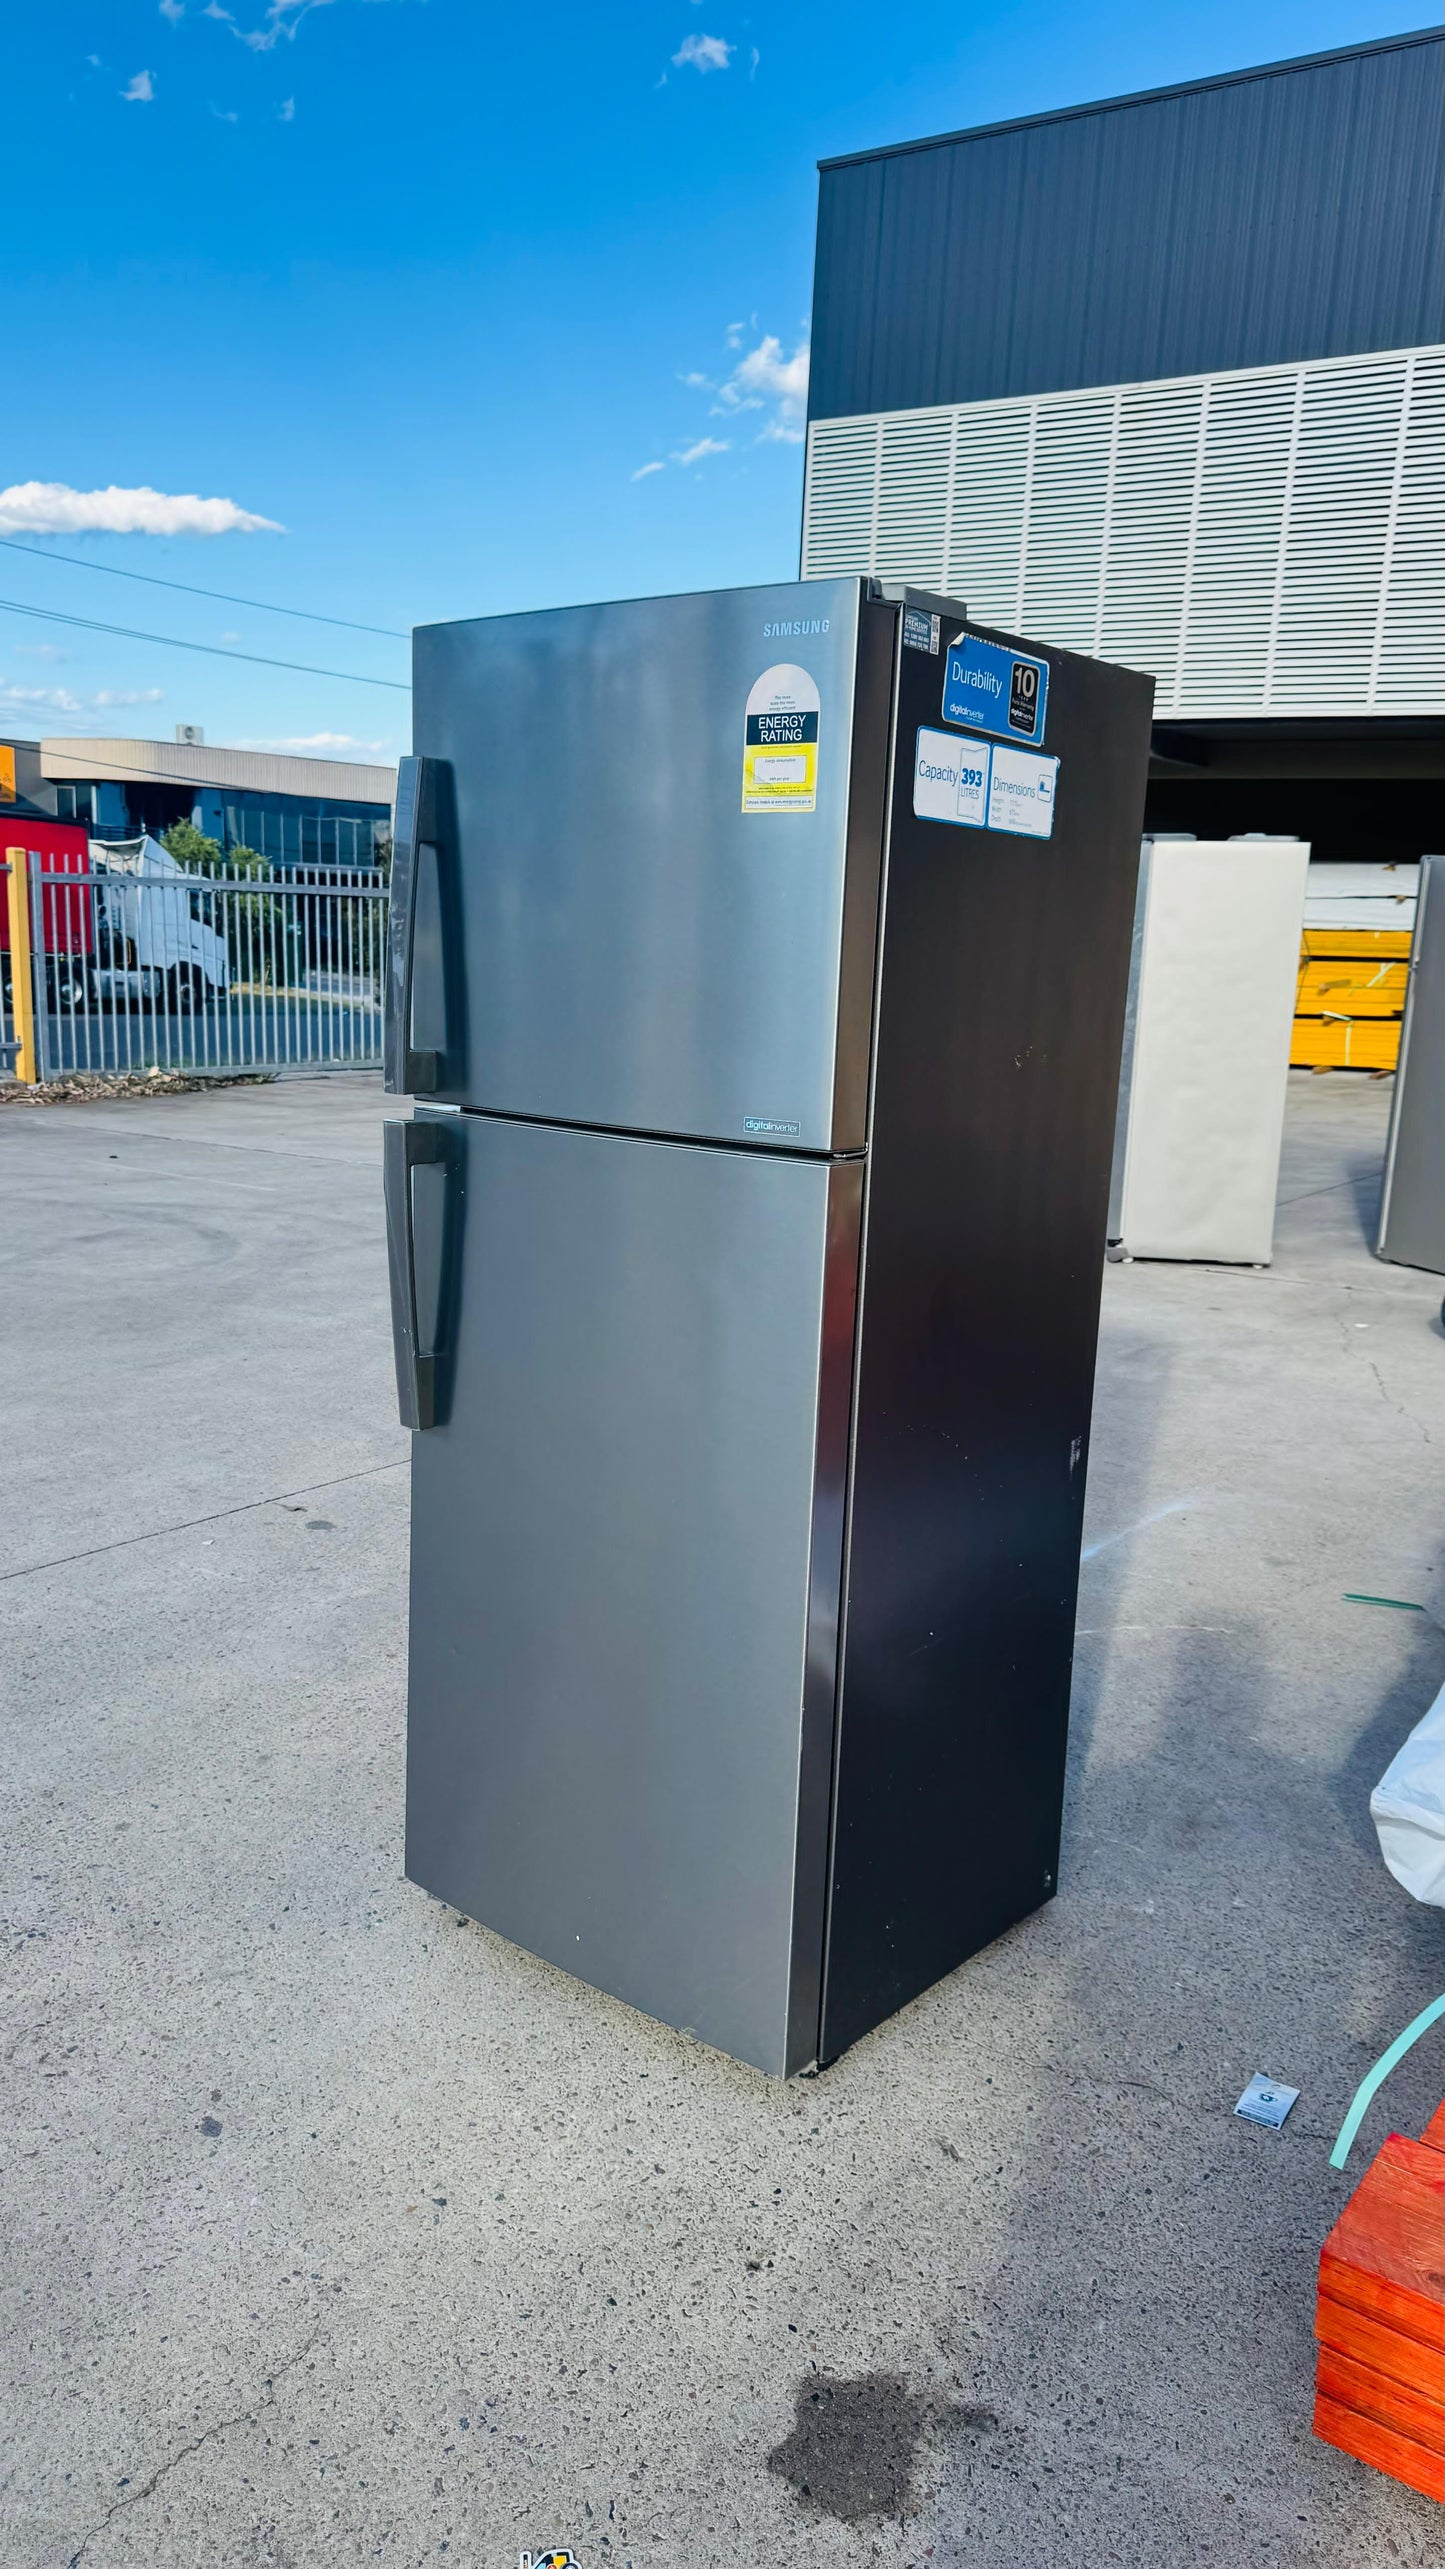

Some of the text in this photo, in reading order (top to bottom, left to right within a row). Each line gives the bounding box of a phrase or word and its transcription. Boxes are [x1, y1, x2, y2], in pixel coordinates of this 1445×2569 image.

[763, 619, 830, 637] SAMSUNG
[952, 661, 1003, 699] Durability
[1015, 667, 1035, 698] 10
[758, 715, 807, 729] ENERGY
[760, 729, 803, 742] RATING
[918, 760, 959, 787] Capacity
[961, 768, 983, 787] 393
[960, 787, 980, 800] LITRES
[993, 777, 1036, 798] Dimensions
[746, 1120, 798, 1133] digitalinverter
